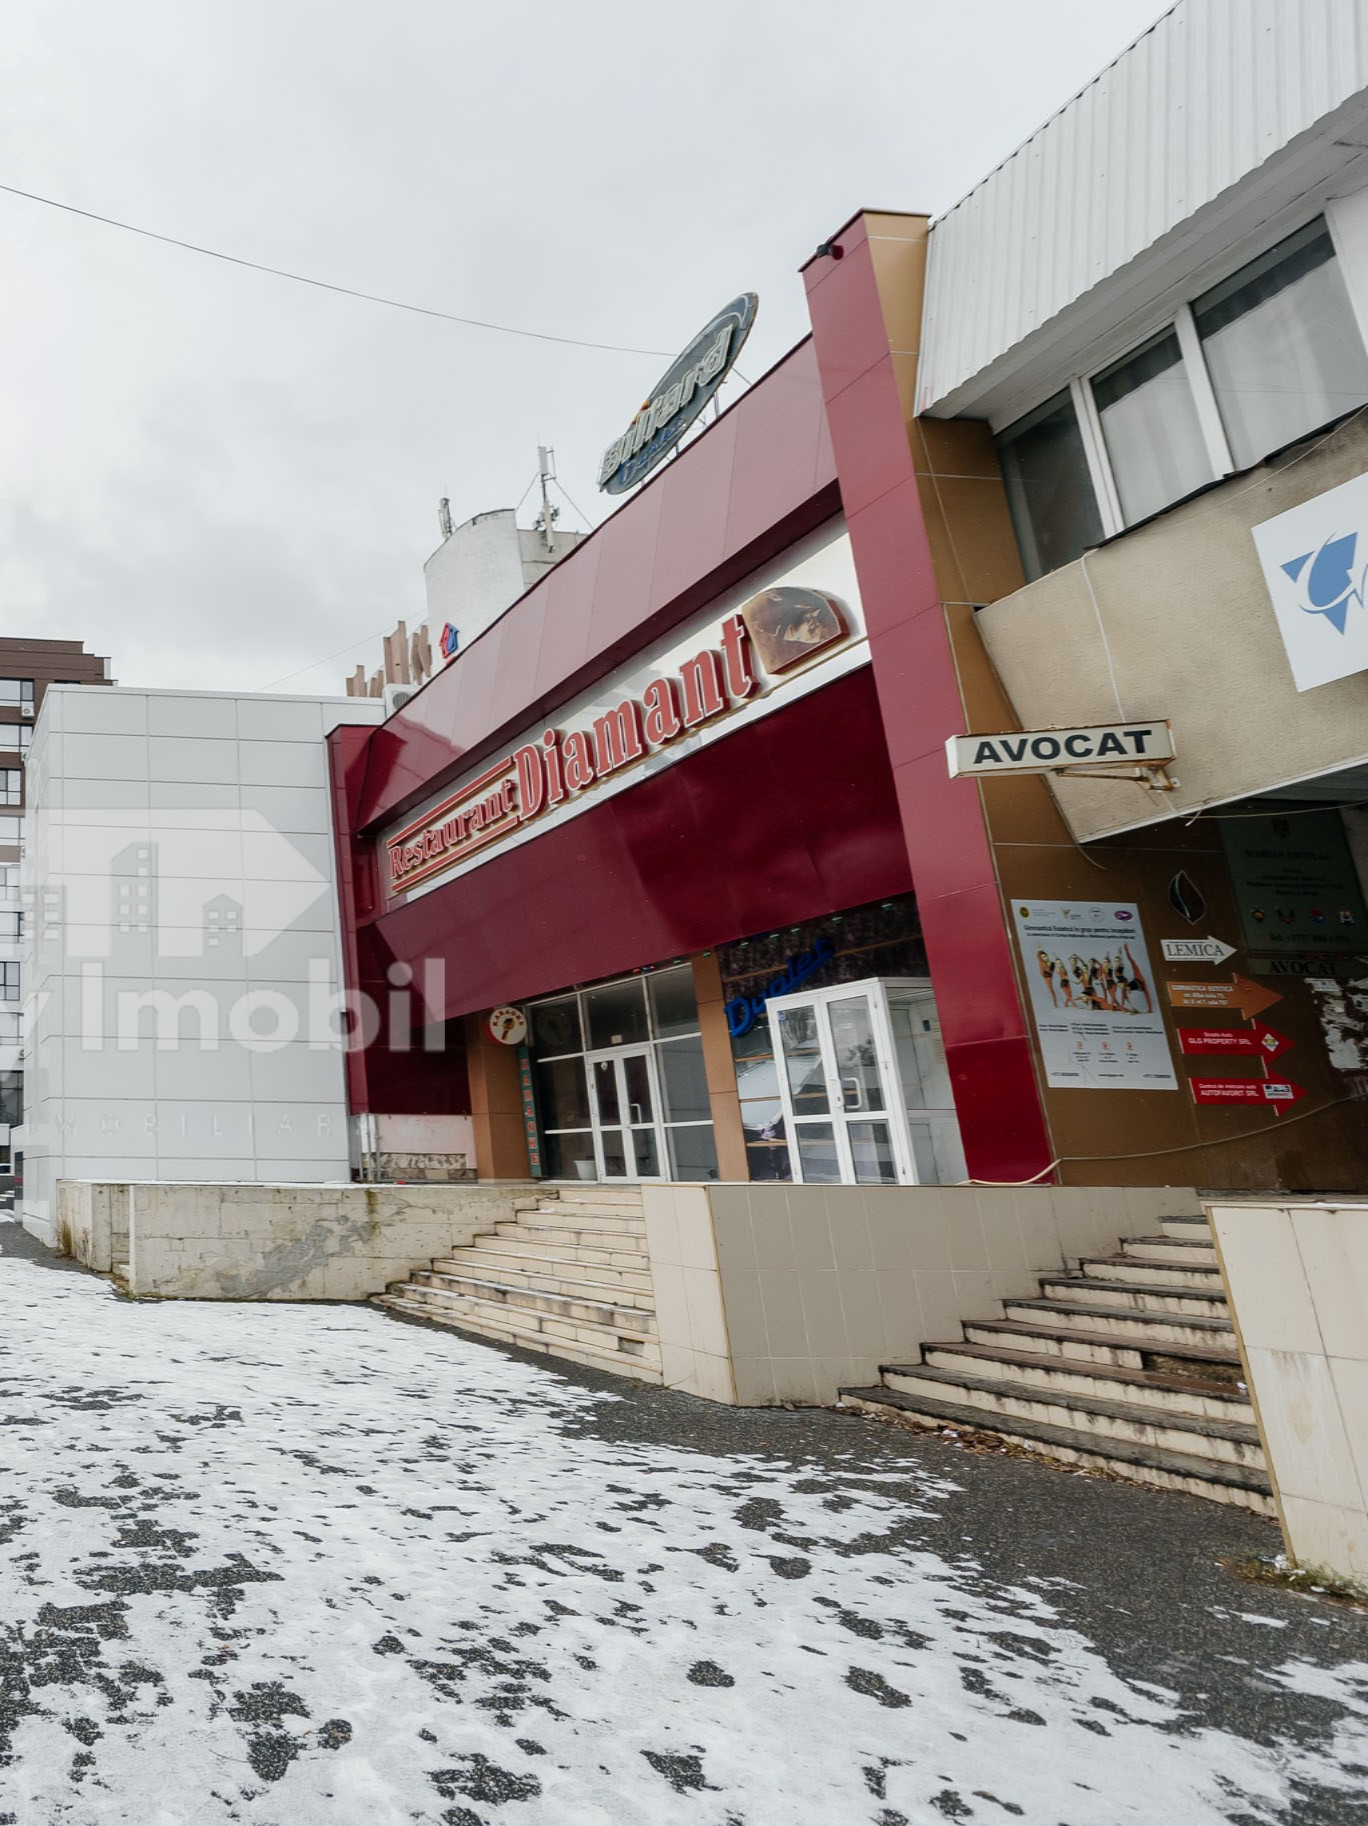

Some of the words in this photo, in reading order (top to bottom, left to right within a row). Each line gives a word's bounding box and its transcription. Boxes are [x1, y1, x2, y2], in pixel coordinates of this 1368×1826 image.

[389, 779, 518, 879] Restaurant
[512, 613, 759, 822] Diamant
[973, 729, 1152, 766] AVOCAT
[1166, 944, 1225, 957] LEMICA
[1270, 961, 1337, 975] AVOCAT
[492, 1006, 525, 1027] KARAOKE
[521, 1058, 540, 1166] KARAOKE
